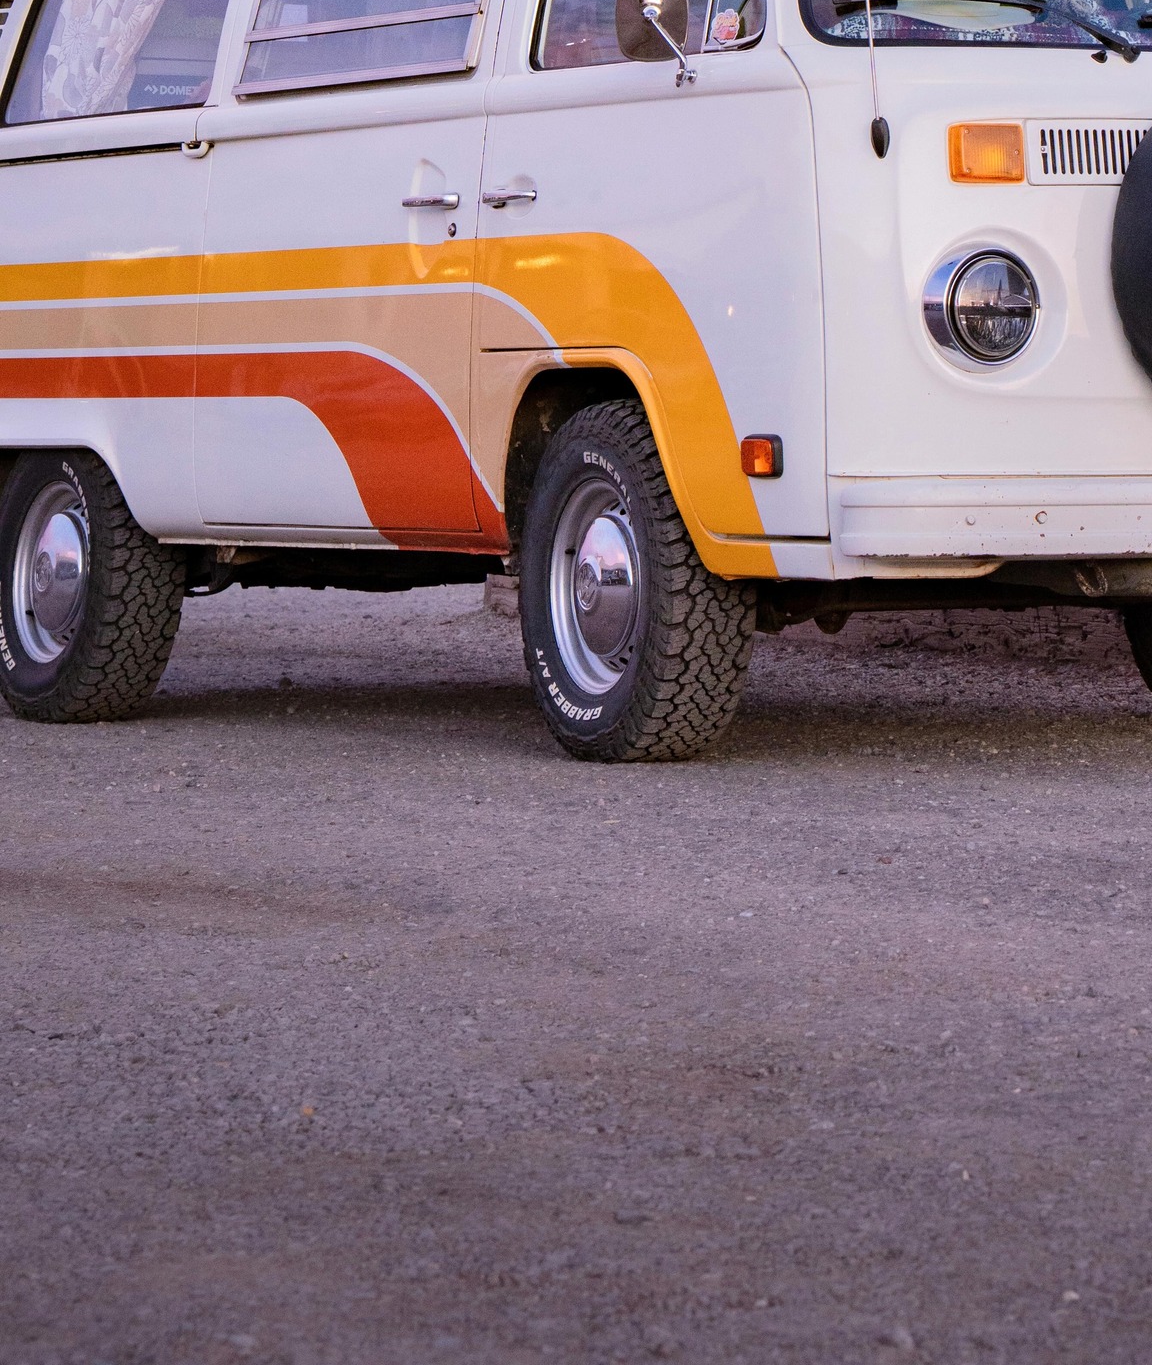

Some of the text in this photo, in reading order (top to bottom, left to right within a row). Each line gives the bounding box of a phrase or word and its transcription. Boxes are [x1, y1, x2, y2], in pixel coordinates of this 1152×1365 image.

[583, 451, 632, 512] GENERAL
[535, 647, 604, 721] GRABBER A/T
